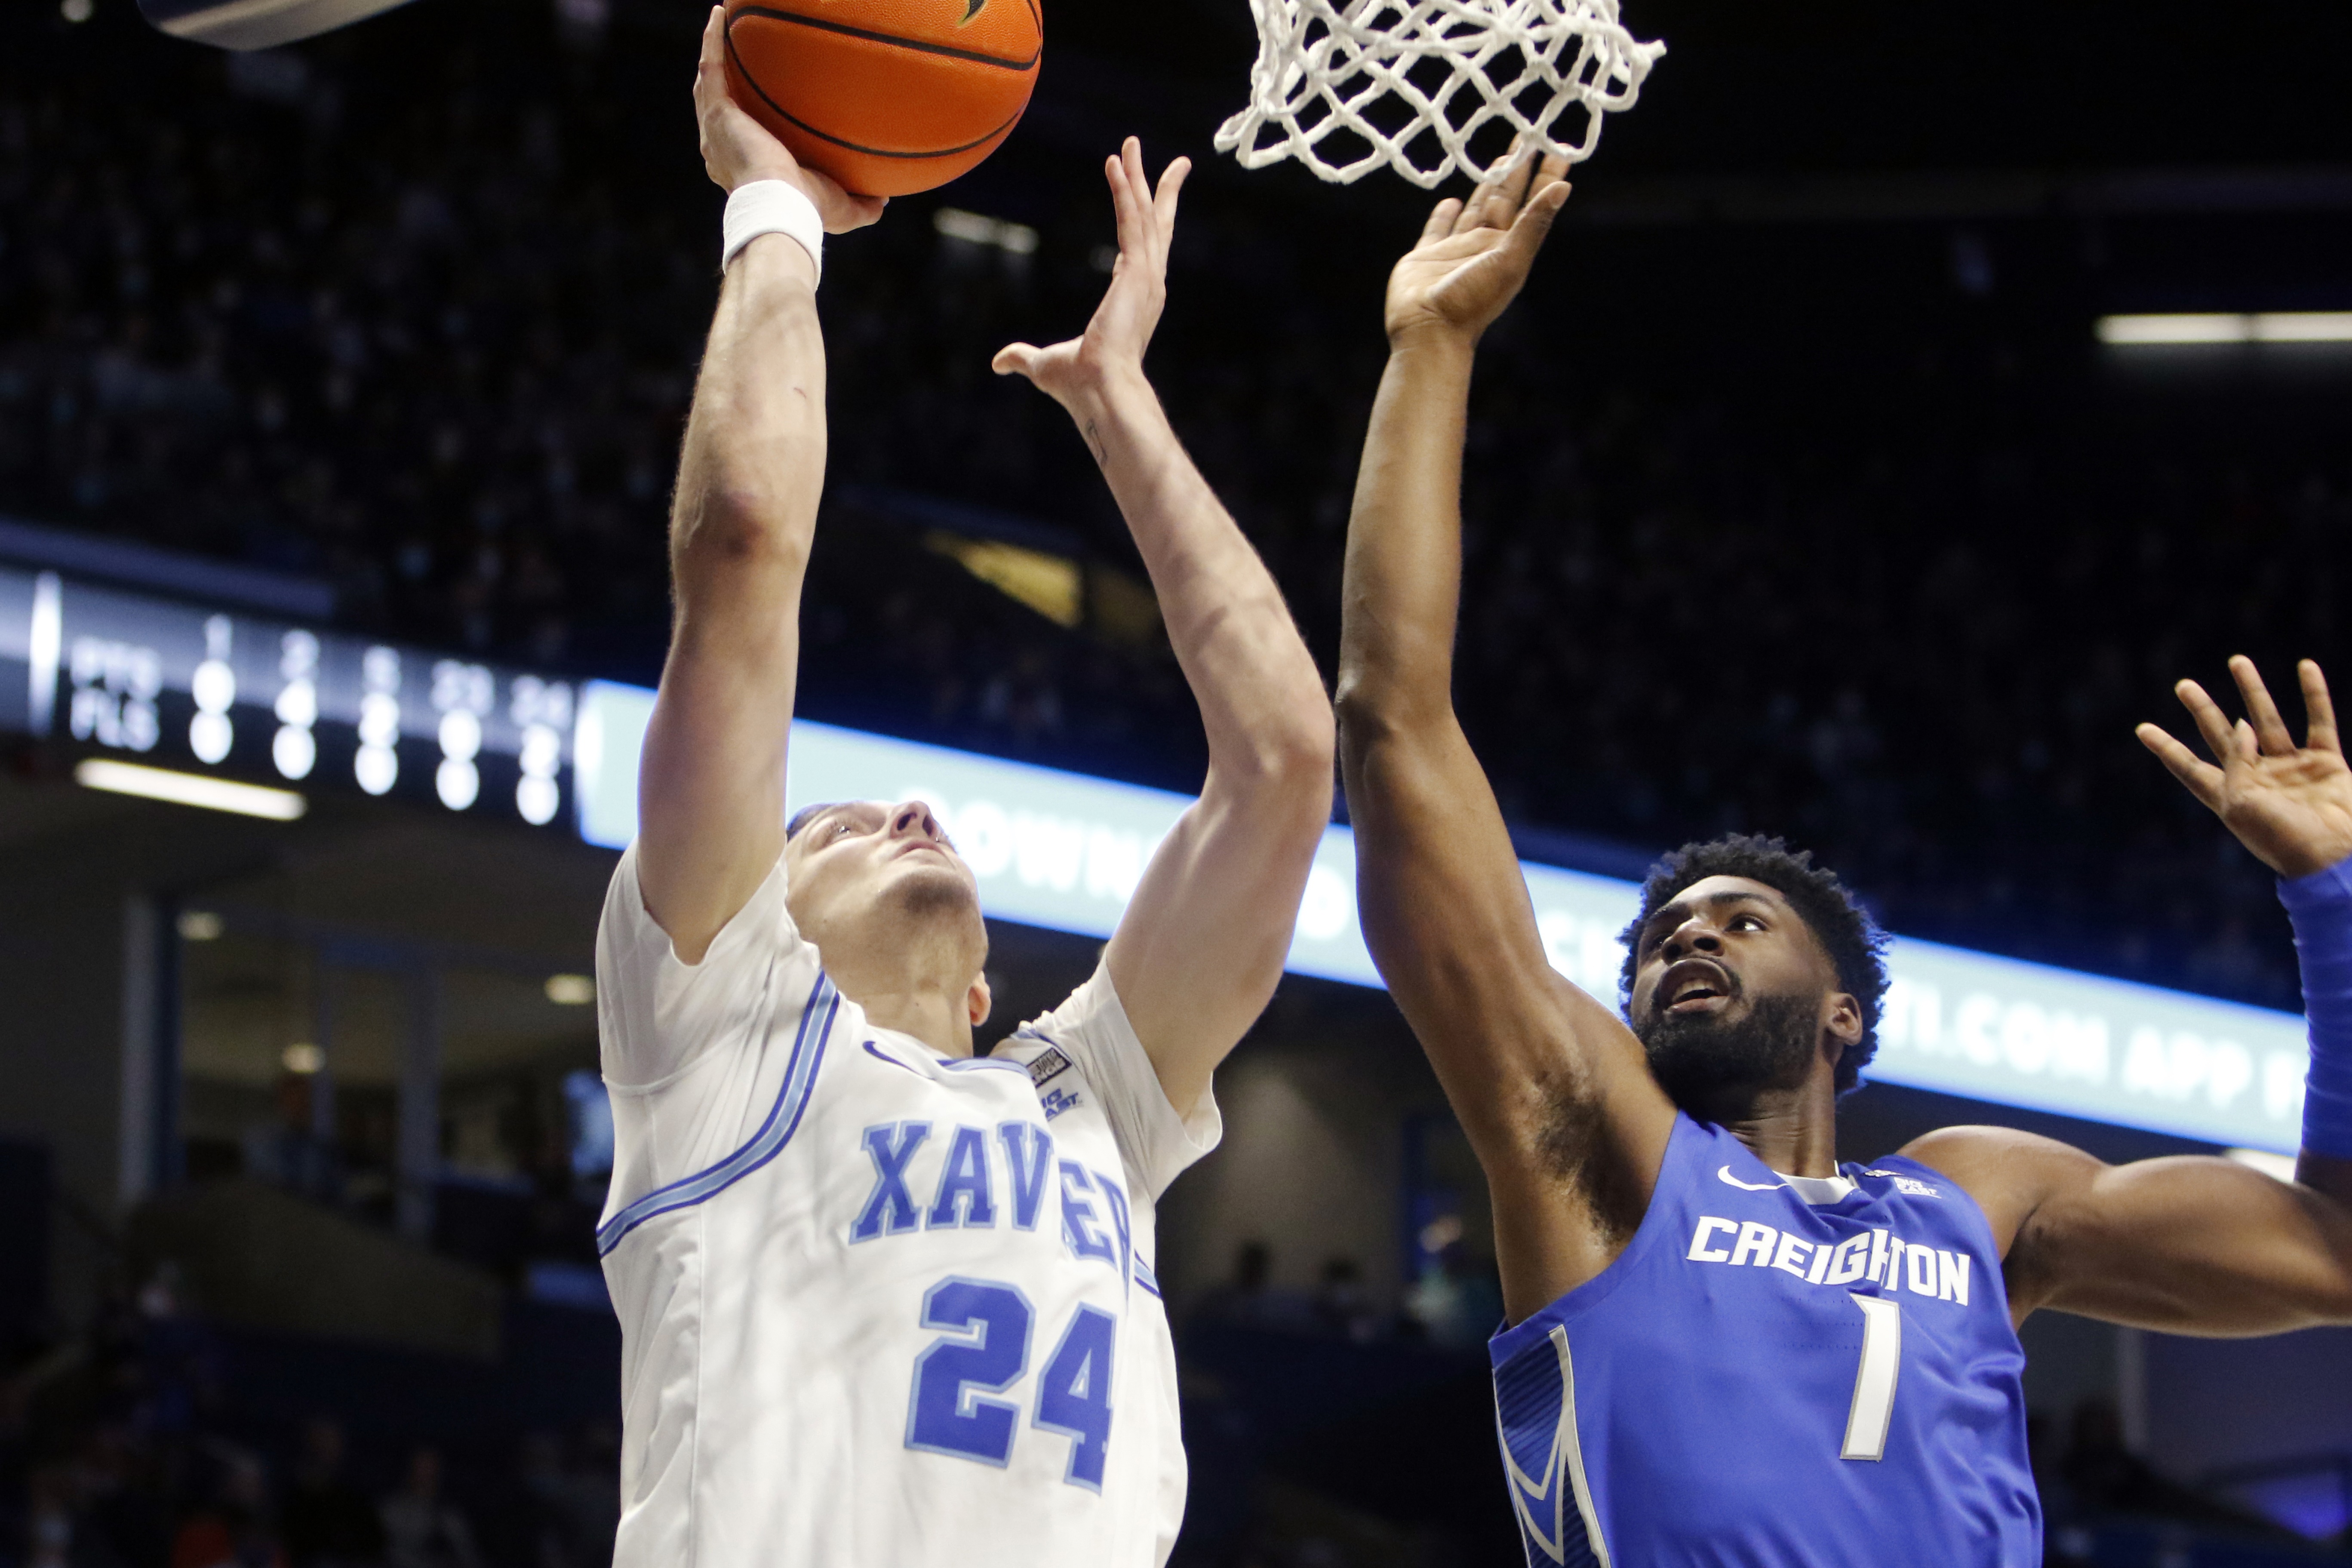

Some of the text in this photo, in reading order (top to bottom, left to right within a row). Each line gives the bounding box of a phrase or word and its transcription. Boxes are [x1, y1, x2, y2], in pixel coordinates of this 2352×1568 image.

[849, 1119, 1131, 1290] XAVER
[1686, 1216, 1971, 1306] CREIGHTON
[904, 1274, 1117, 1497] 24
[1839, 1292, 1901, 1462] 1
